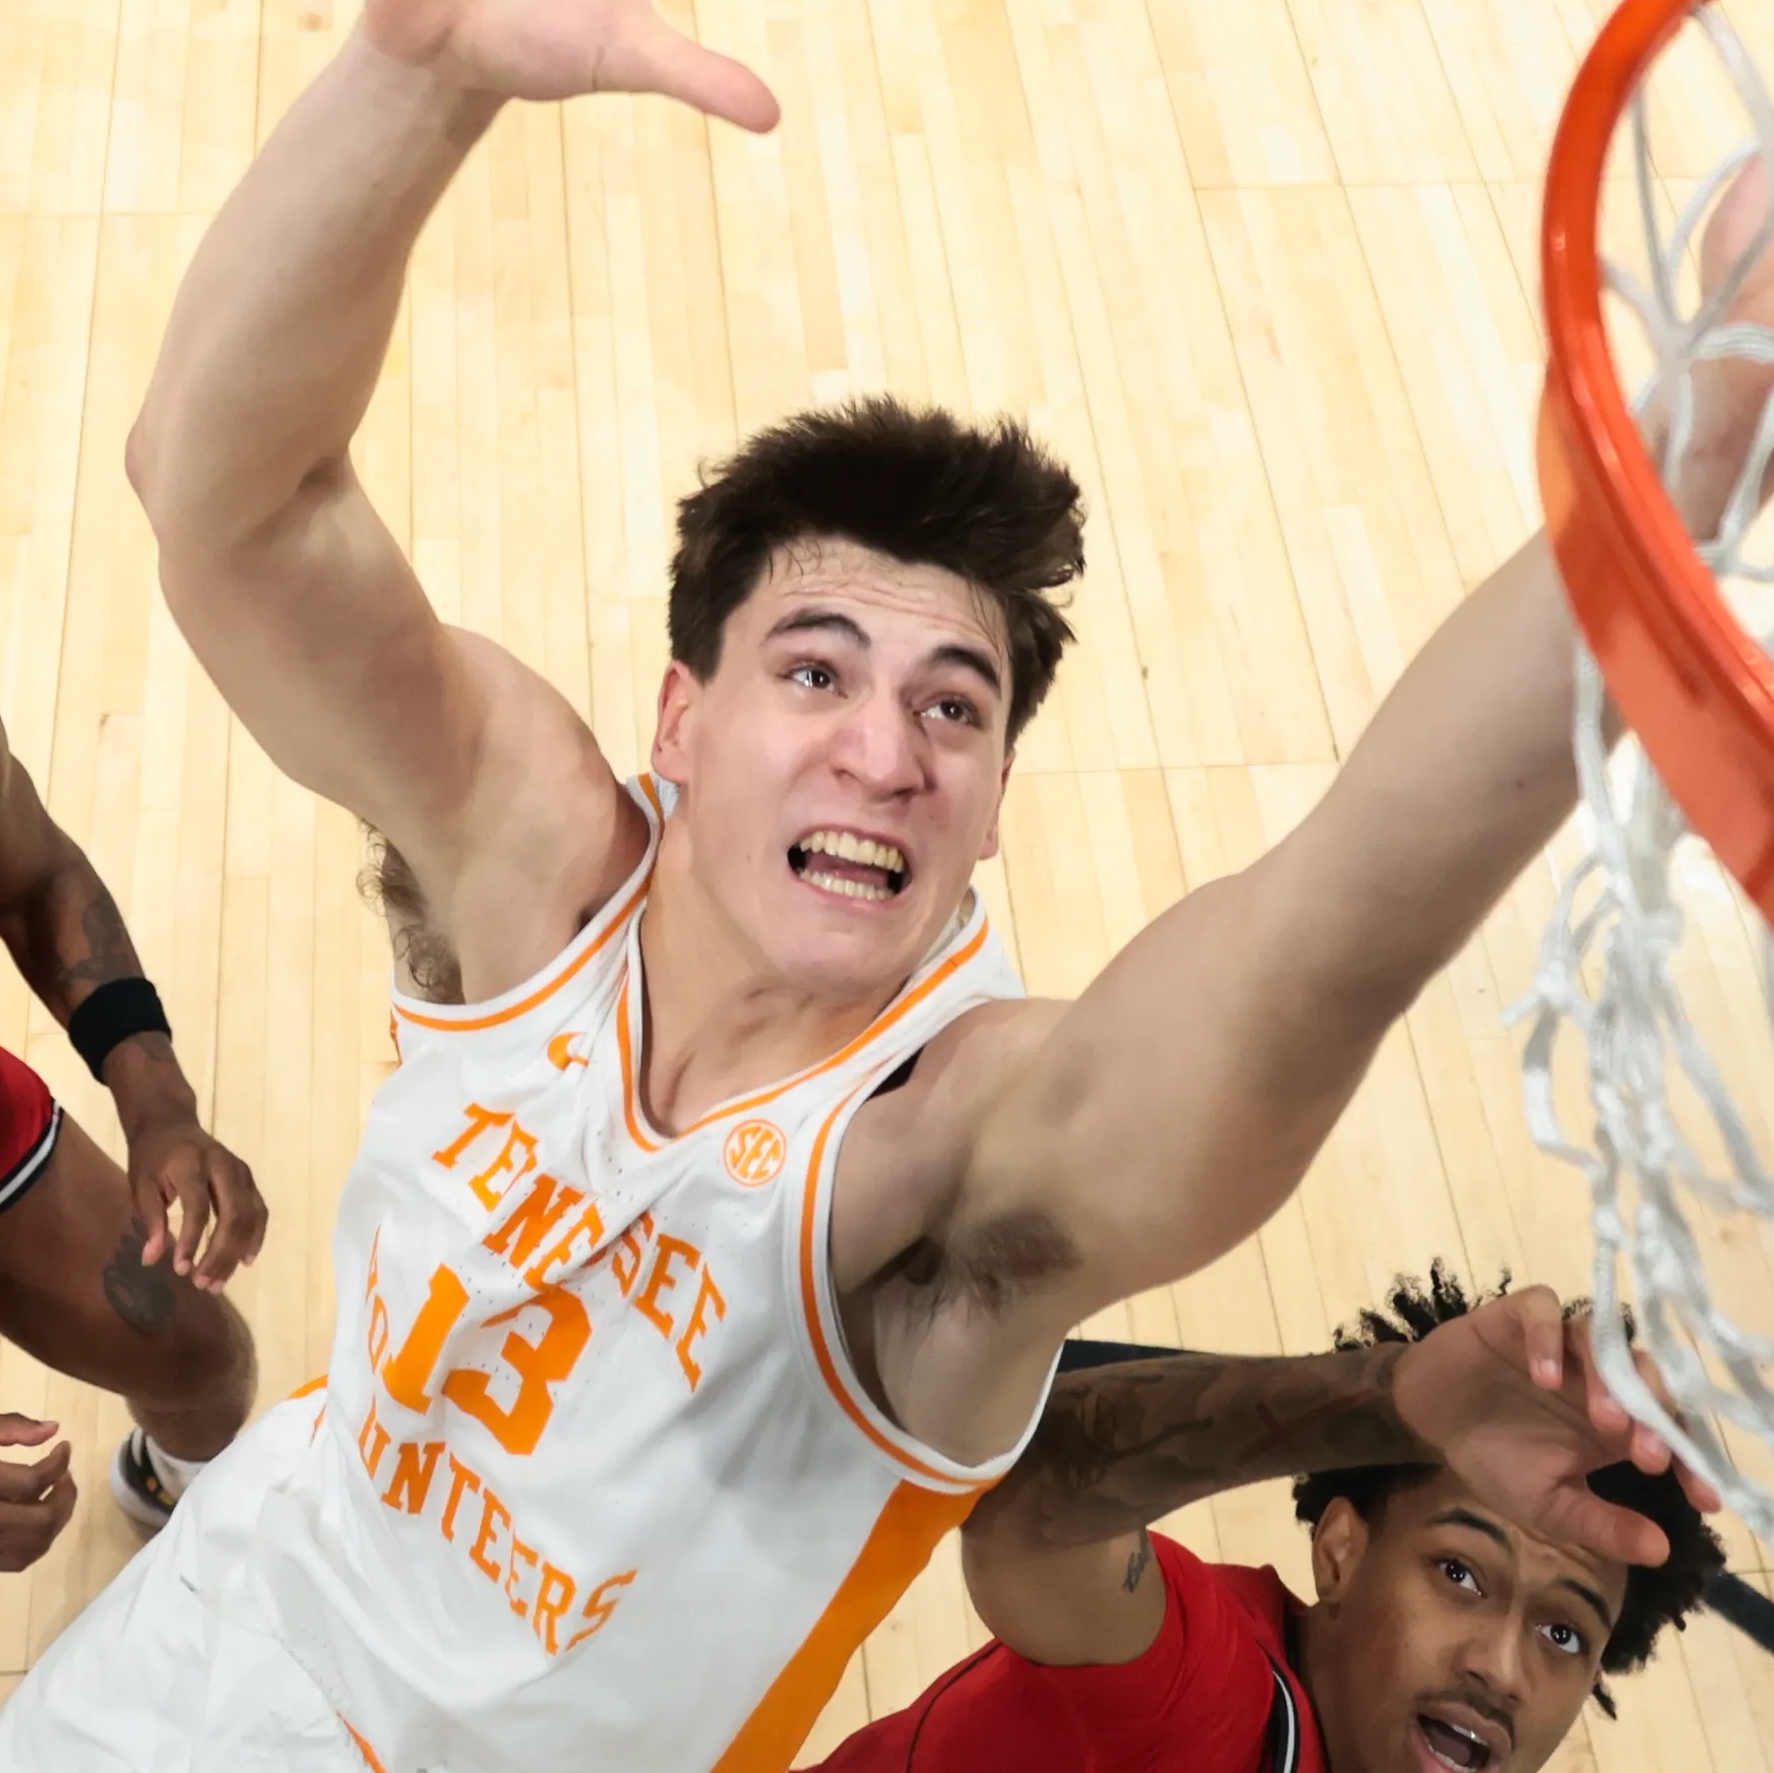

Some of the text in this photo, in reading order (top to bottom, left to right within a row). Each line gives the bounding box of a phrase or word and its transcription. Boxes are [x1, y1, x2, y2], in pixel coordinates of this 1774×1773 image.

[431, 1102, 727, 1393] TENESEE
[729, 1124, 781, 1181] SEC
[357, 1224, 638, 1657] OUNTEERS
[381, 1261, 593, 1456] 13
